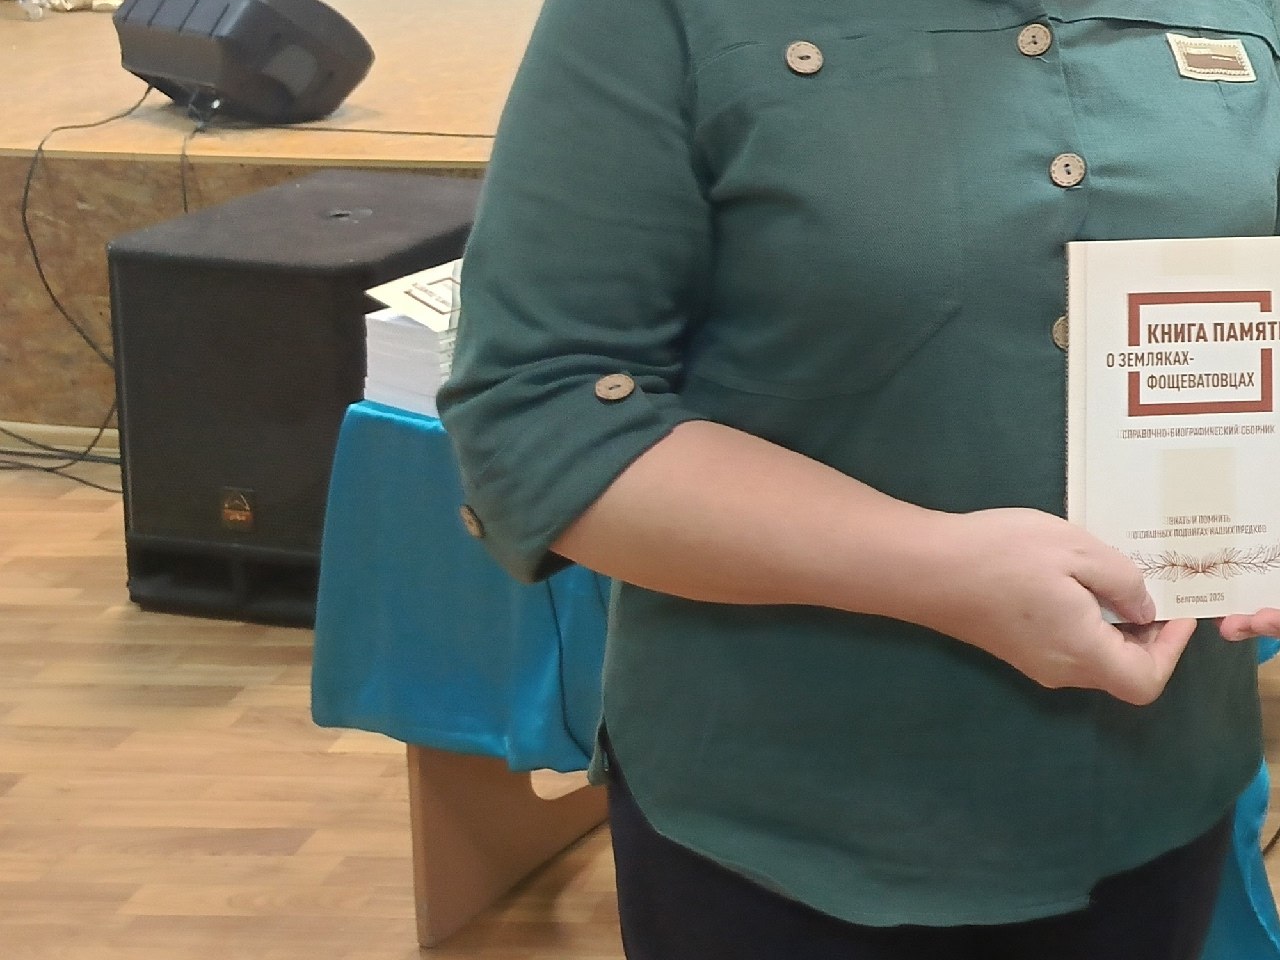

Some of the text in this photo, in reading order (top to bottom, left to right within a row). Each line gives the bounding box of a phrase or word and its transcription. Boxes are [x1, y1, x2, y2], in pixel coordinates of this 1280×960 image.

[1147, 323, 1208, 344] КНИГА
[1106, 351, 1195, 368] О ЗЕМЛЯКАХ-
[1147, 371, 1255, 392] ФОЩЕВАТОВЦАХ
[1241, 424, 1275, 436] СБОРНИК
[1176, 594, 1208, 604] Белгород
